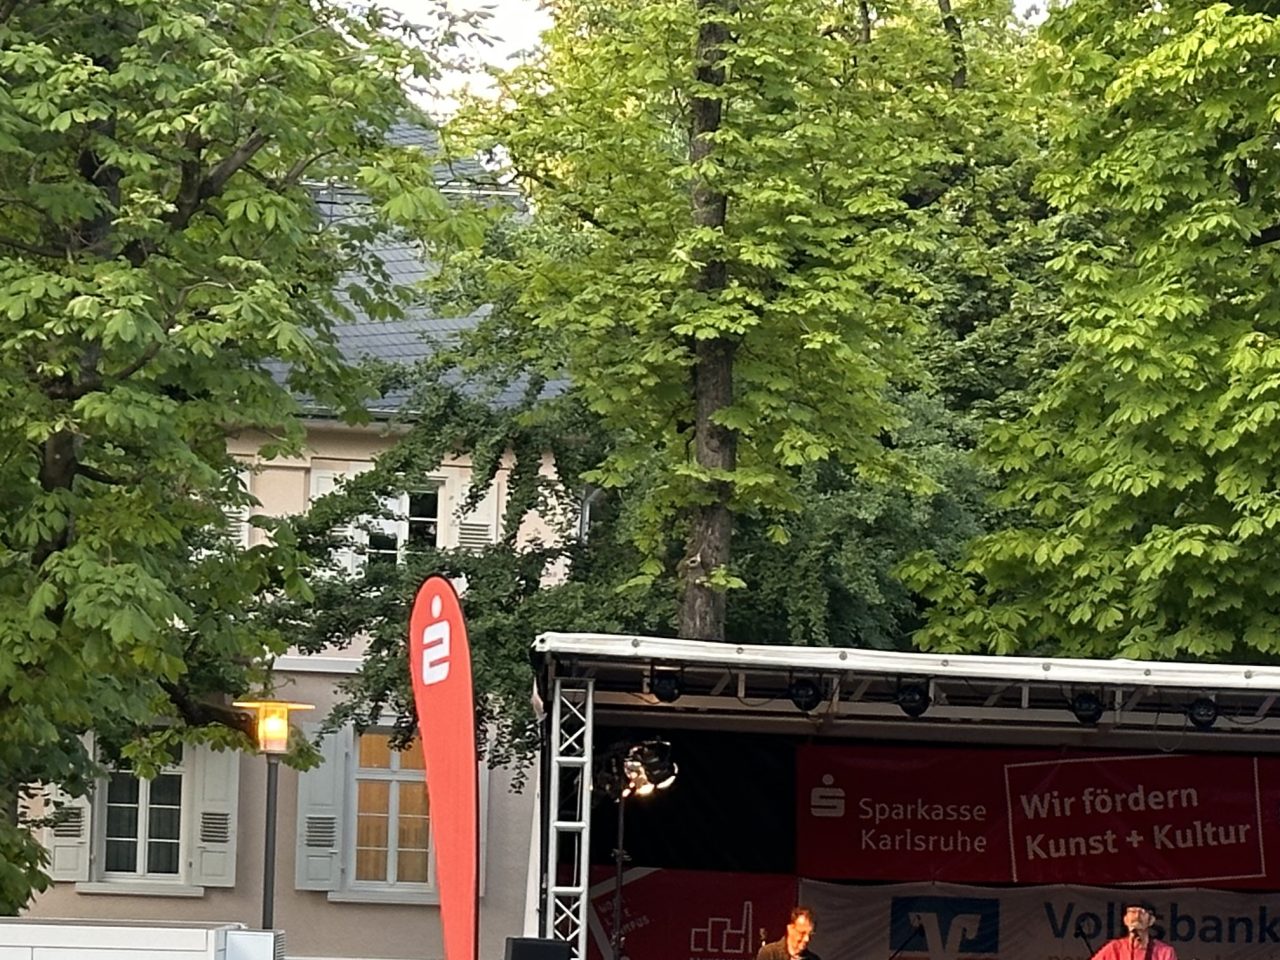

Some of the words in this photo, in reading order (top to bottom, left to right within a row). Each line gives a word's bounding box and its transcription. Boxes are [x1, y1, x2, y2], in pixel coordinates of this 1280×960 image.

[859, 798, 987, 824] Sparkasse
[1020, 790, 1076, 820] Wir
[1082, 784, 1200, 815] fördern
[861, 829, 987, 853] Karlsruhe
[1025, 830, 1119, 860] Kunst
[1153, 821, 1250, 850] Kultur
